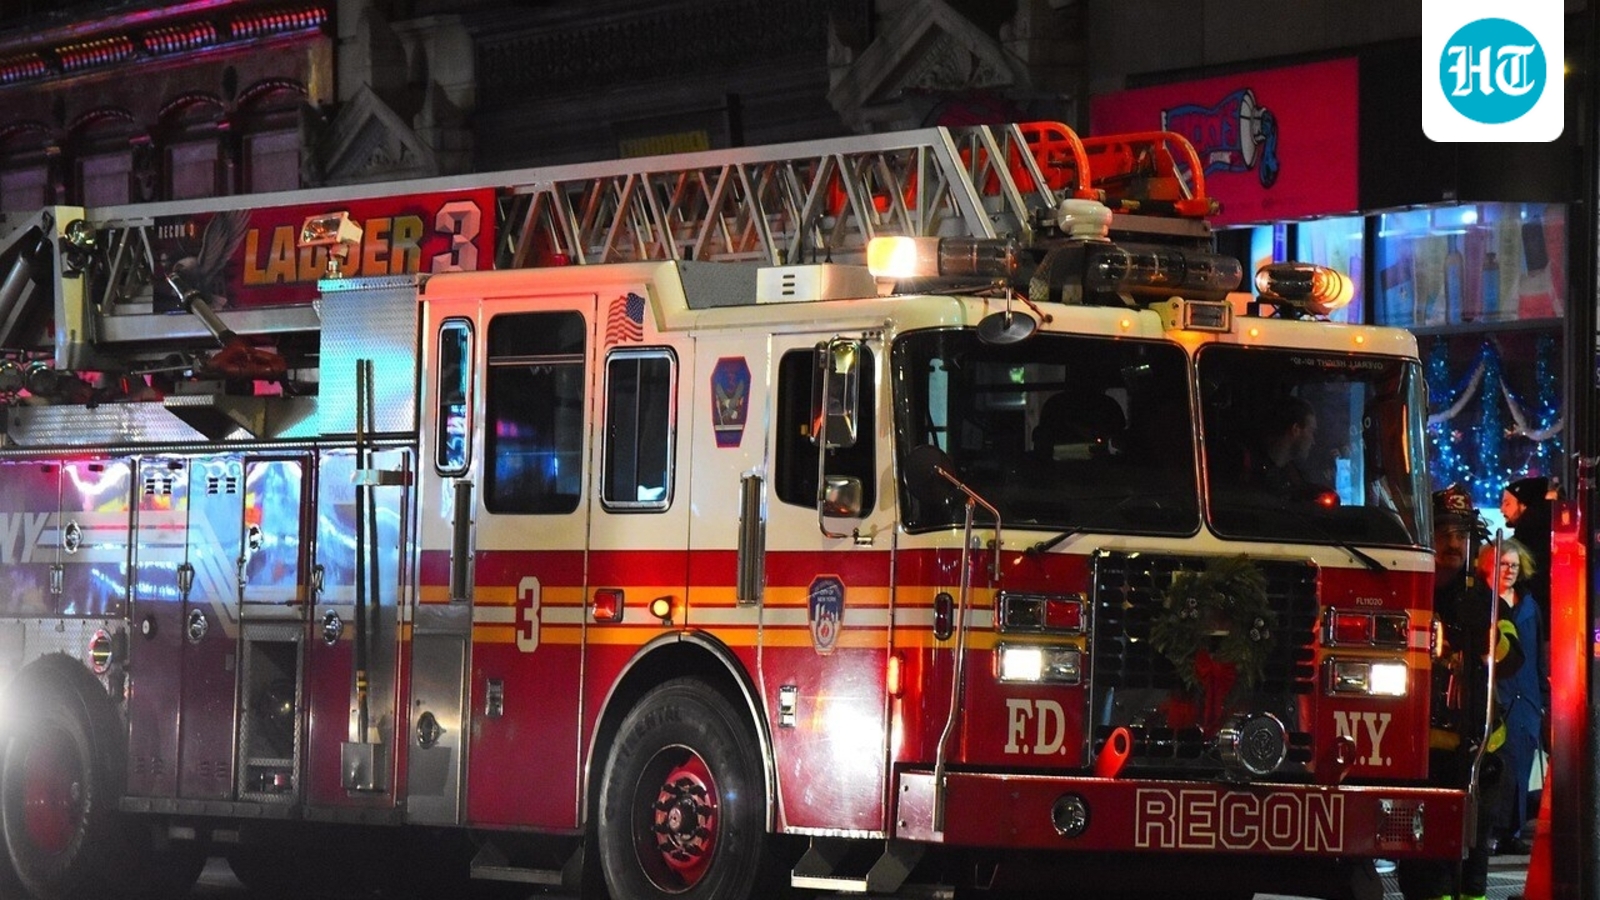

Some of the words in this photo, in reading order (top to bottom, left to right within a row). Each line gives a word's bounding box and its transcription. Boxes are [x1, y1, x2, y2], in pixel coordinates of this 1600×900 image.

[432, 200, 482, 271] 3
[1452, 495, 1466, 509] 3
[516, 576, 541, 653] 3
[1004, 698, 1067, 755] F.D.
[1135, 788, 1345, 852] RECON
